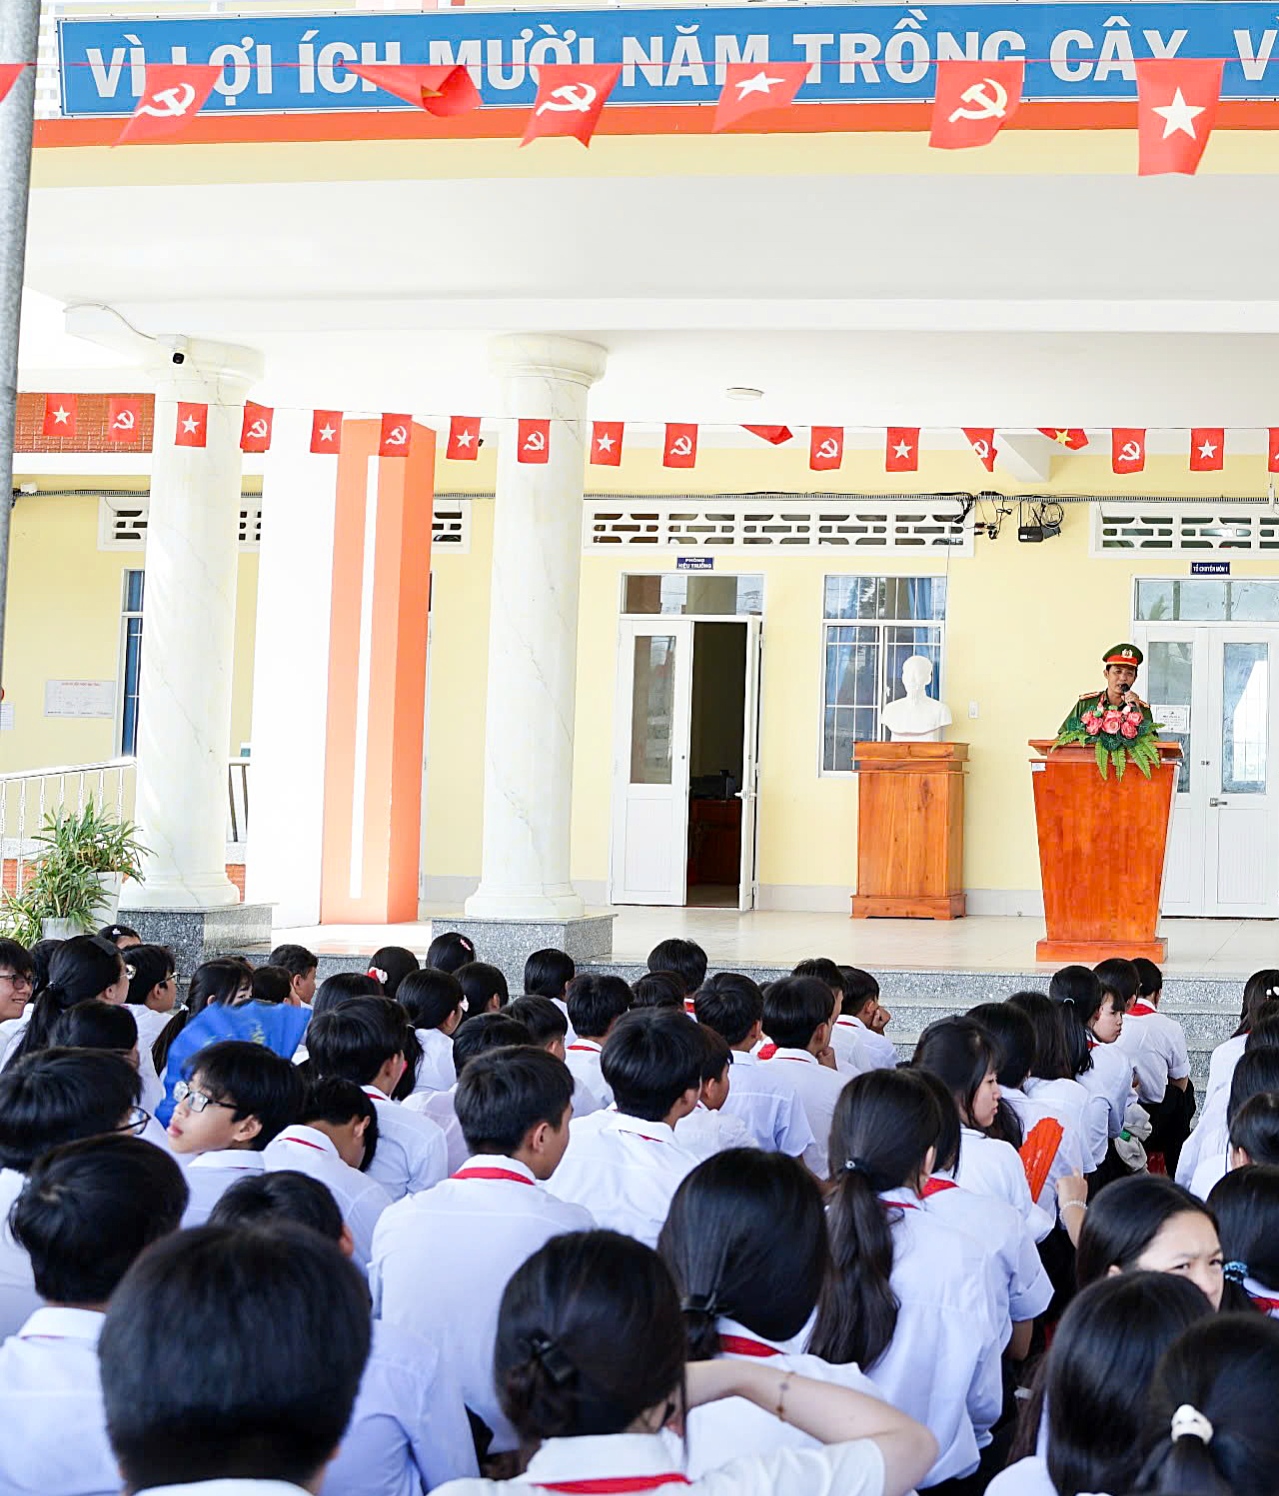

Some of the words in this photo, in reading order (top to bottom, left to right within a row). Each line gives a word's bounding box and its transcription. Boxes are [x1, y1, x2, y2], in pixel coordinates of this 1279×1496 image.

[86, 34, 146, 97] VÌ
[298, 29, 401, 93] ÍCH
[622, 25, 769, 87] NĂM
[792, 9, 1026, 84] TRỒNG
[1049, 15, 1188, 82] CÂY
